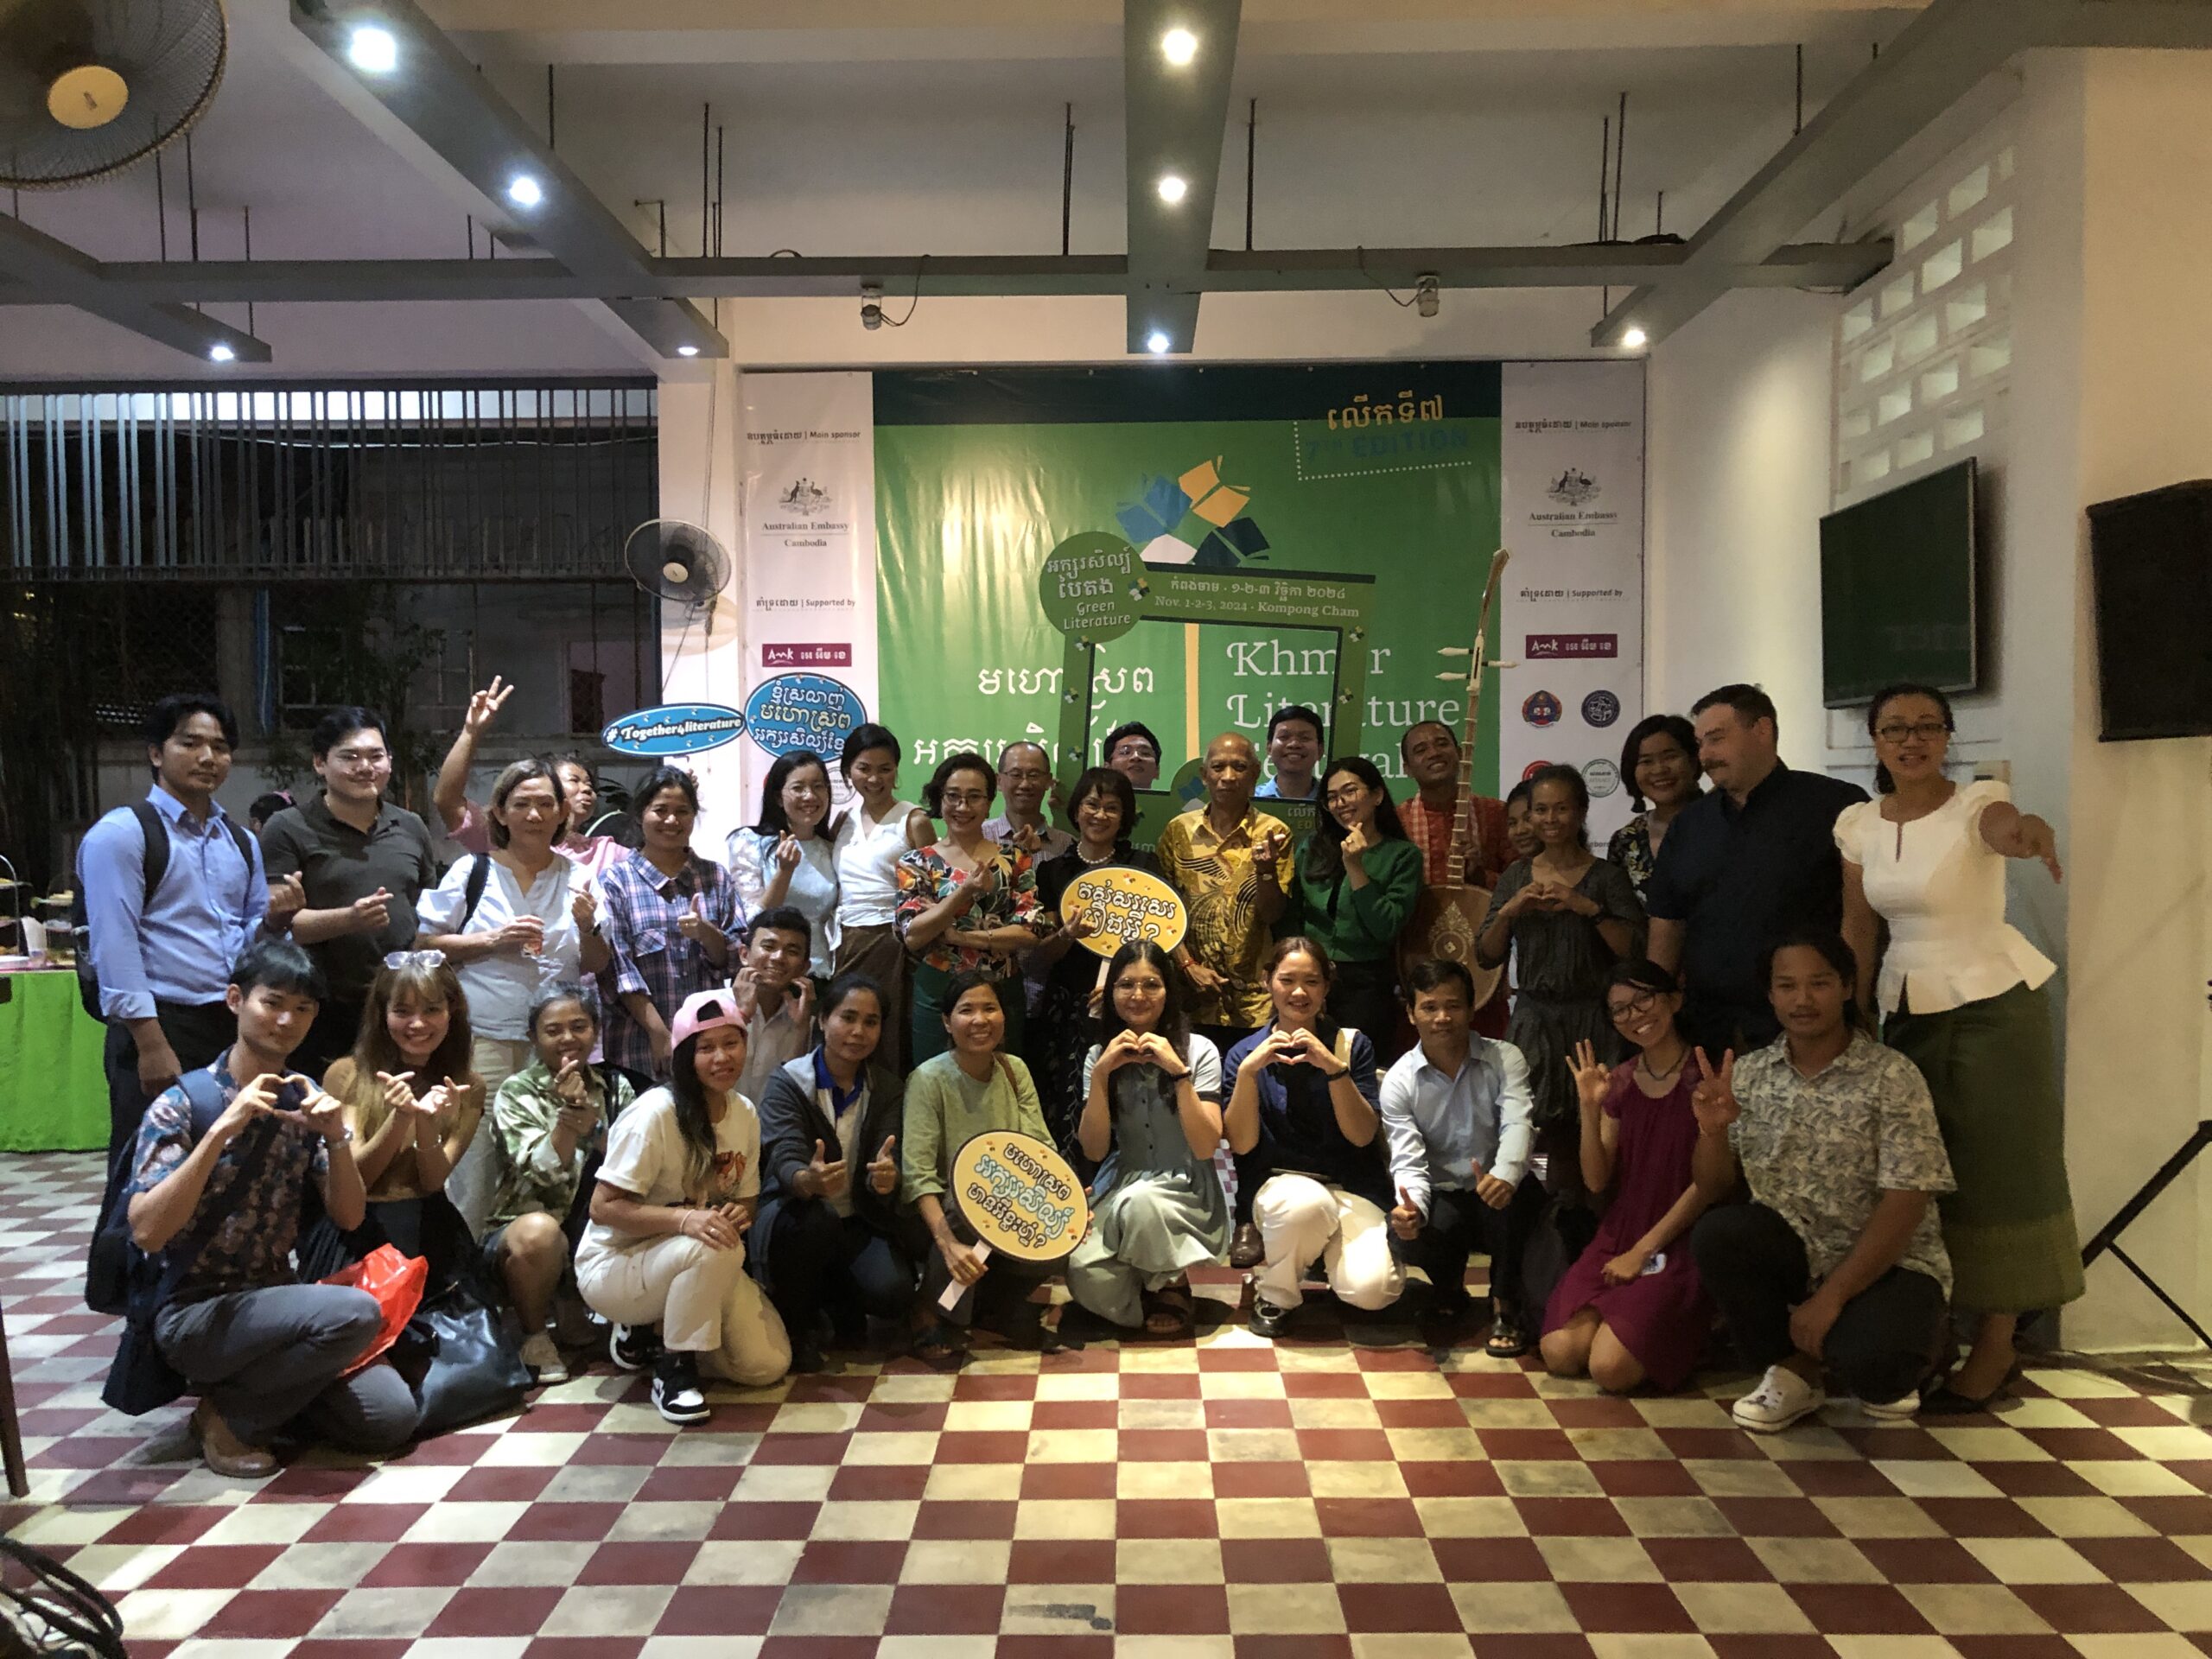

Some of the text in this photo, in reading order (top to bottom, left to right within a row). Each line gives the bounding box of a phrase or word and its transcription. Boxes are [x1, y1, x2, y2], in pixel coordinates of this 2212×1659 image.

[1326, 390, 1444, 430] លើកទី៧
[1601, 421, 1631, 430] sponsor
[831, 431, 861, 441] sponsor
[1529, 512, 1618, 521] Australian Embassy
[762, 522, 849, 531] Australian Embassy
[1551, 529, 1596, 537] Cambodia
[785, 538, 827, 547] Cambodia
[1058, 575, 1114, 598] បៃតង
[1306, 586, 1345, 600] ២០២៤
[1573, 589, 1611, 599] Supported
[1614, 589, 1623, 598] by
[805, 598, 845, 608] Supported
[847, 598, 855, 607] by
[1077, 601, 1115, 616] Green
[1154, 595, 1180, 607] Nov.
[1220, 601, 1248, 613] 2024
[1258, 601, 1319, 617] Kompong
[1321, 605, 1359, 618] Cham
[1064, 614, 1131, 630] Literature
[1226, 639, 1391, 677] Khmr
[1226, 691, 1460, 729] Litrture
[760, 704, 851, 732] មហោស្រព
[753, 727, 845, 755] អក្សរសិល្ប៍ខ្មែ
[1004, 1142, 1071, 1200] មហោស្រព
